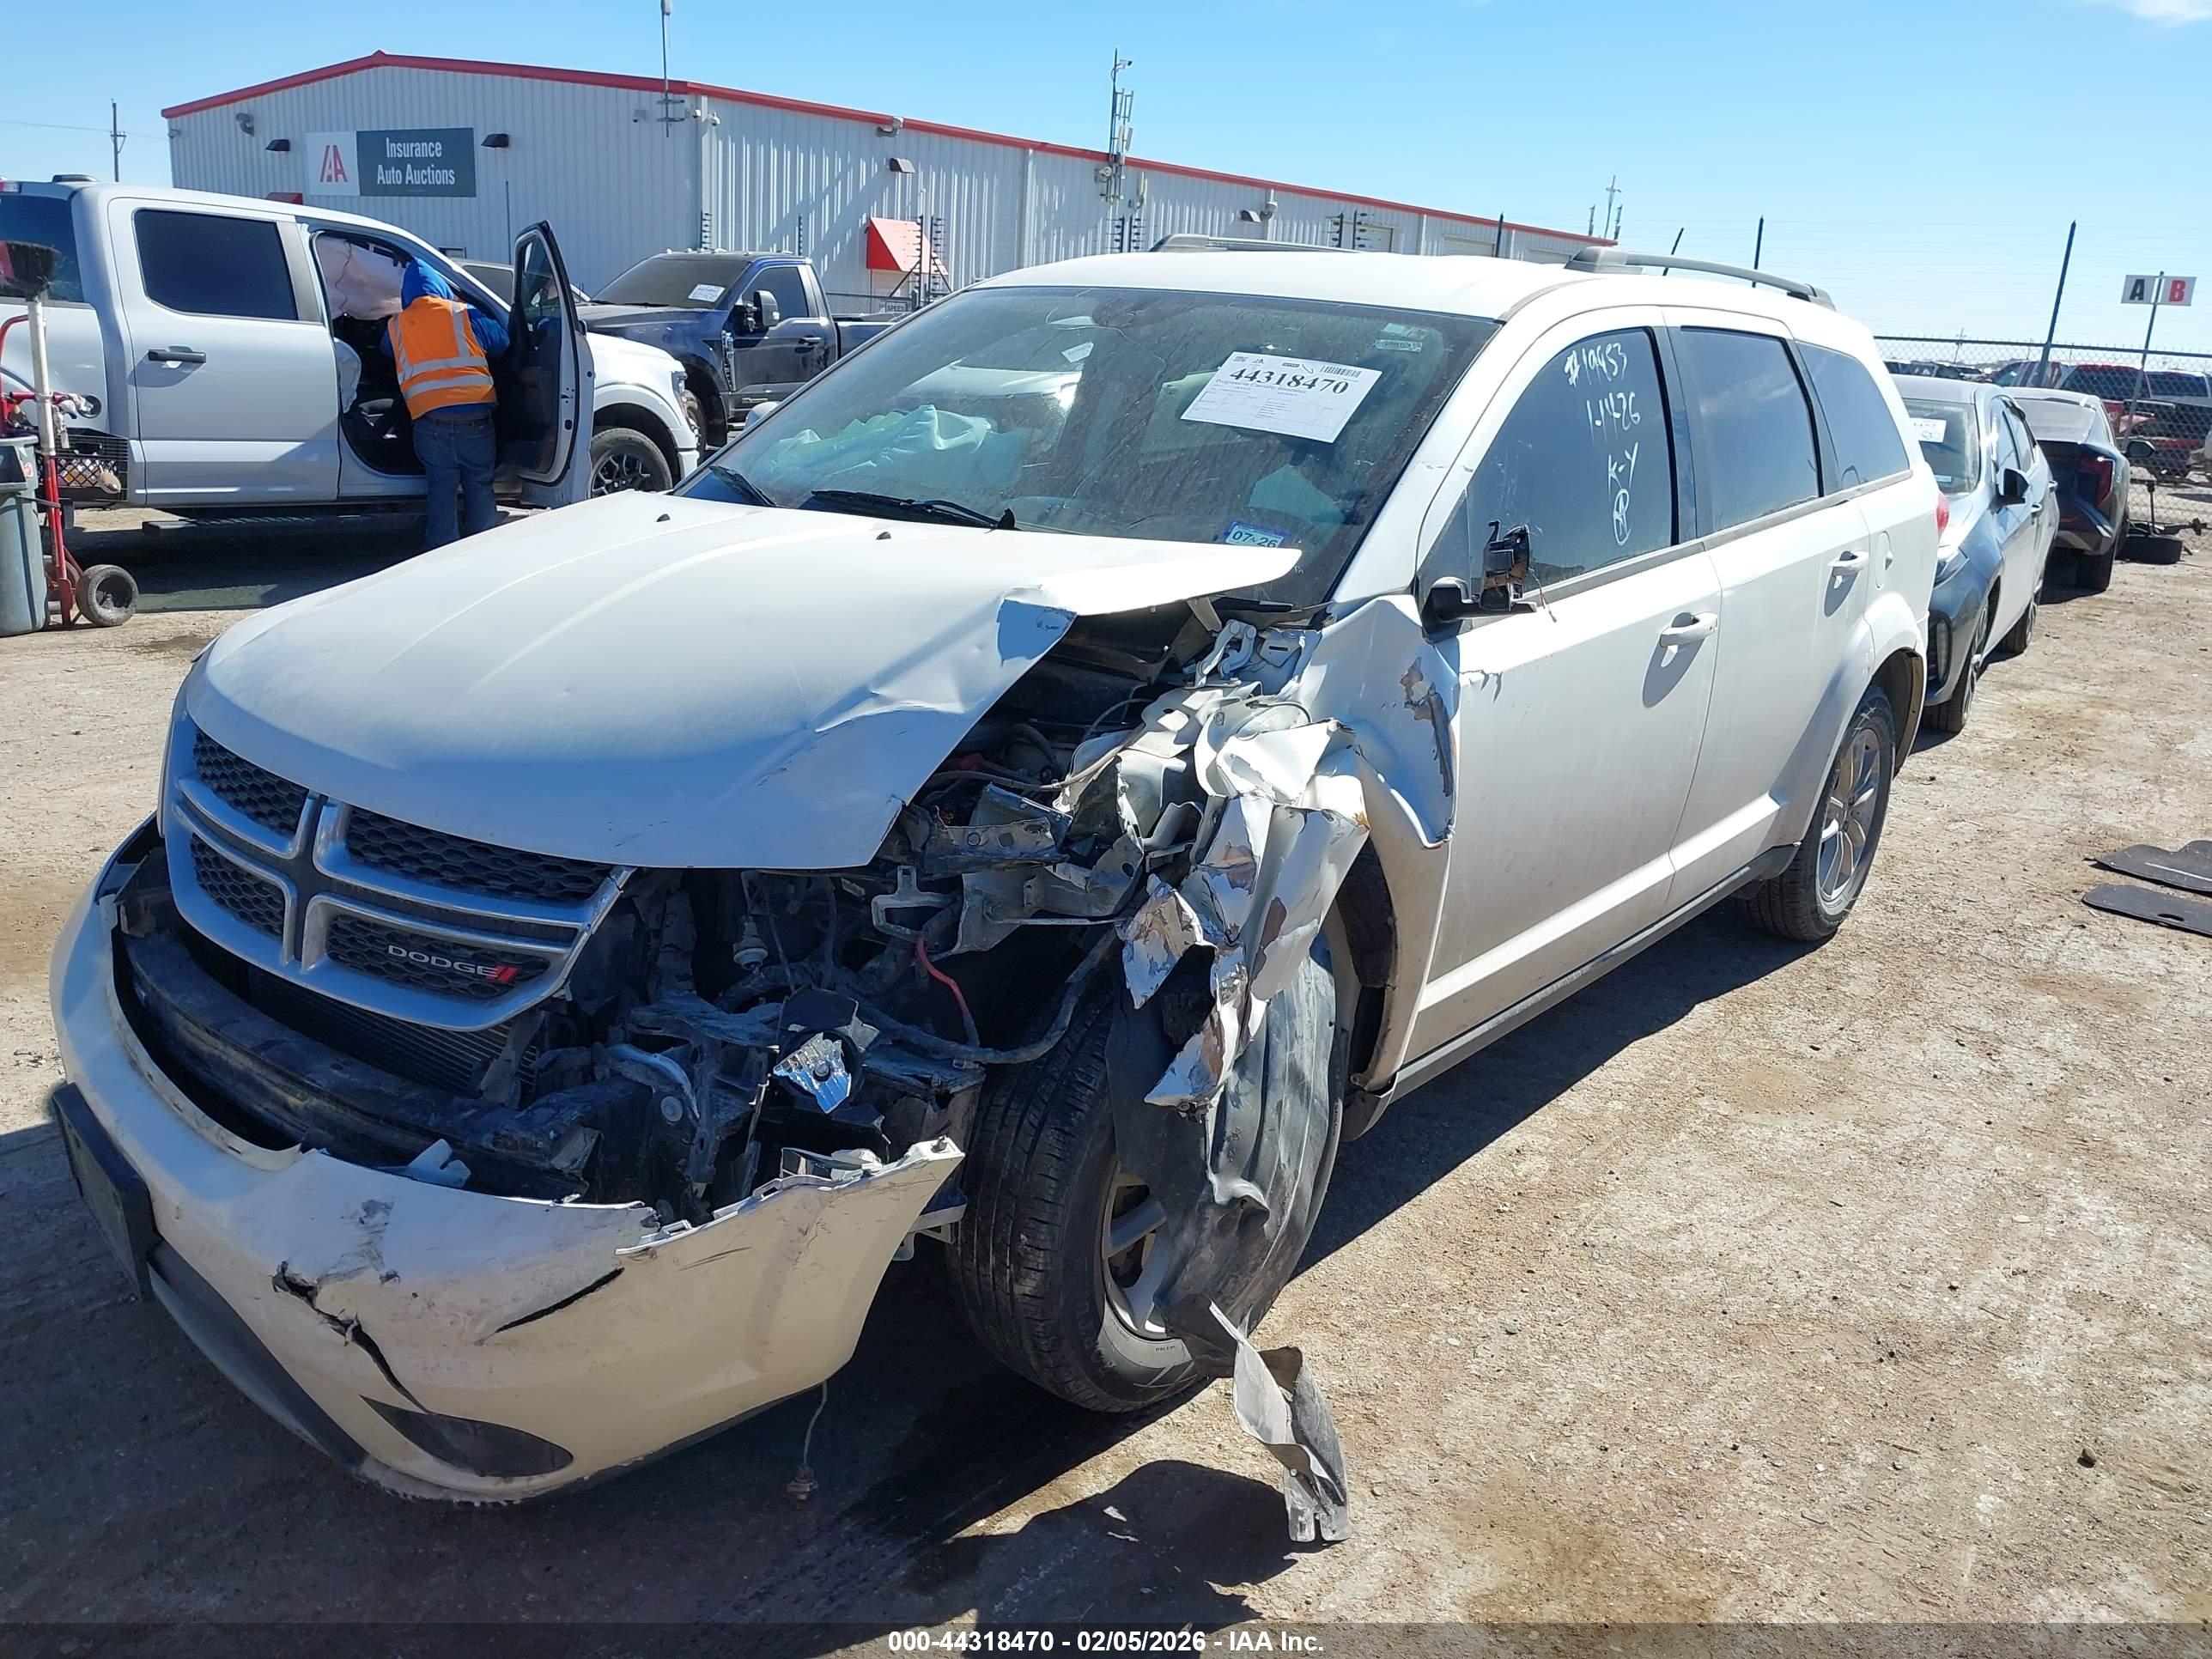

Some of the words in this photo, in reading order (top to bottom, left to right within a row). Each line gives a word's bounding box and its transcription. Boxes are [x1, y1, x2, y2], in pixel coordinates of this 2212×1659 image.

[386, 137, 443, 158] Insurance
[377, 164, 404, 185] Auto
[404, 163, 456, 185] Auctions
[2129, 278, 2145, 301] A
[2168, 279, 2186, 302] B
[1230, 368, 1350, 395] 44318470
[388, 945, 498, 977] DODGE
